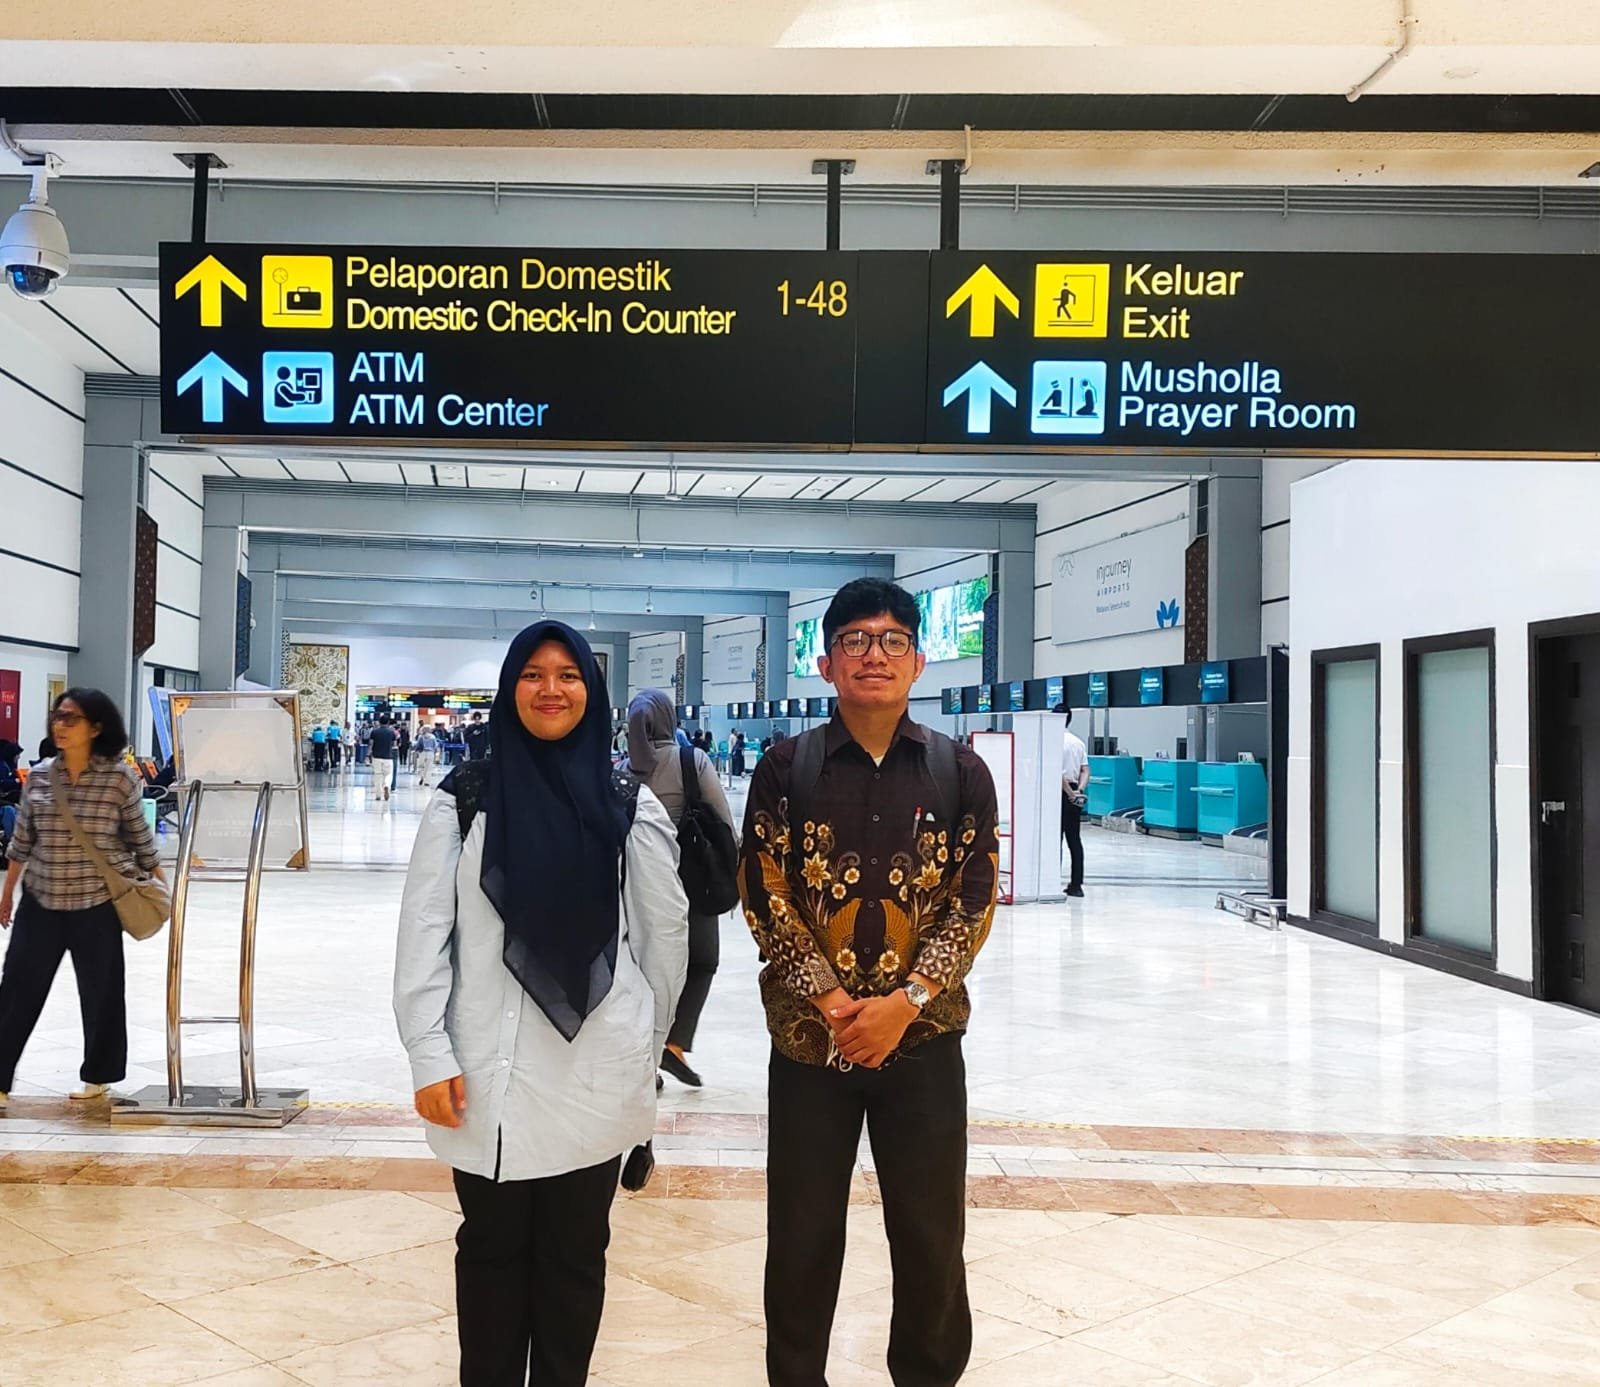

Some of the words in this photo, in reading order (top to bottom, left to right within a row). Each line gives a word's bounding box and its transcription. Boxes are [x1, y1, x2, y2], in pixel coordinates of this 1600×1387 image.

[346, 256, 508, 296] Pelaporan
[521, 258, 672, 291] Domestik
[1124, 263, 1245, 296] Keluar
[777, 279, 849, 317] 1-48
[347, 298, 479, 332] Domestic
[486, 299, 612, 334] Check-In
[622, 301, 737, 336] Counter
[1122, 306, 1191, 339] Exit
[348, 351, 424, 383] ATM
[1120, 360, 1282, 394] Musholla
[349, 393, 425, 425] ATM
[437, 394, 549, 427] Center
[1119, 395, 1239, 436] Prayer
[1249, 396, 1356, 429] Room
